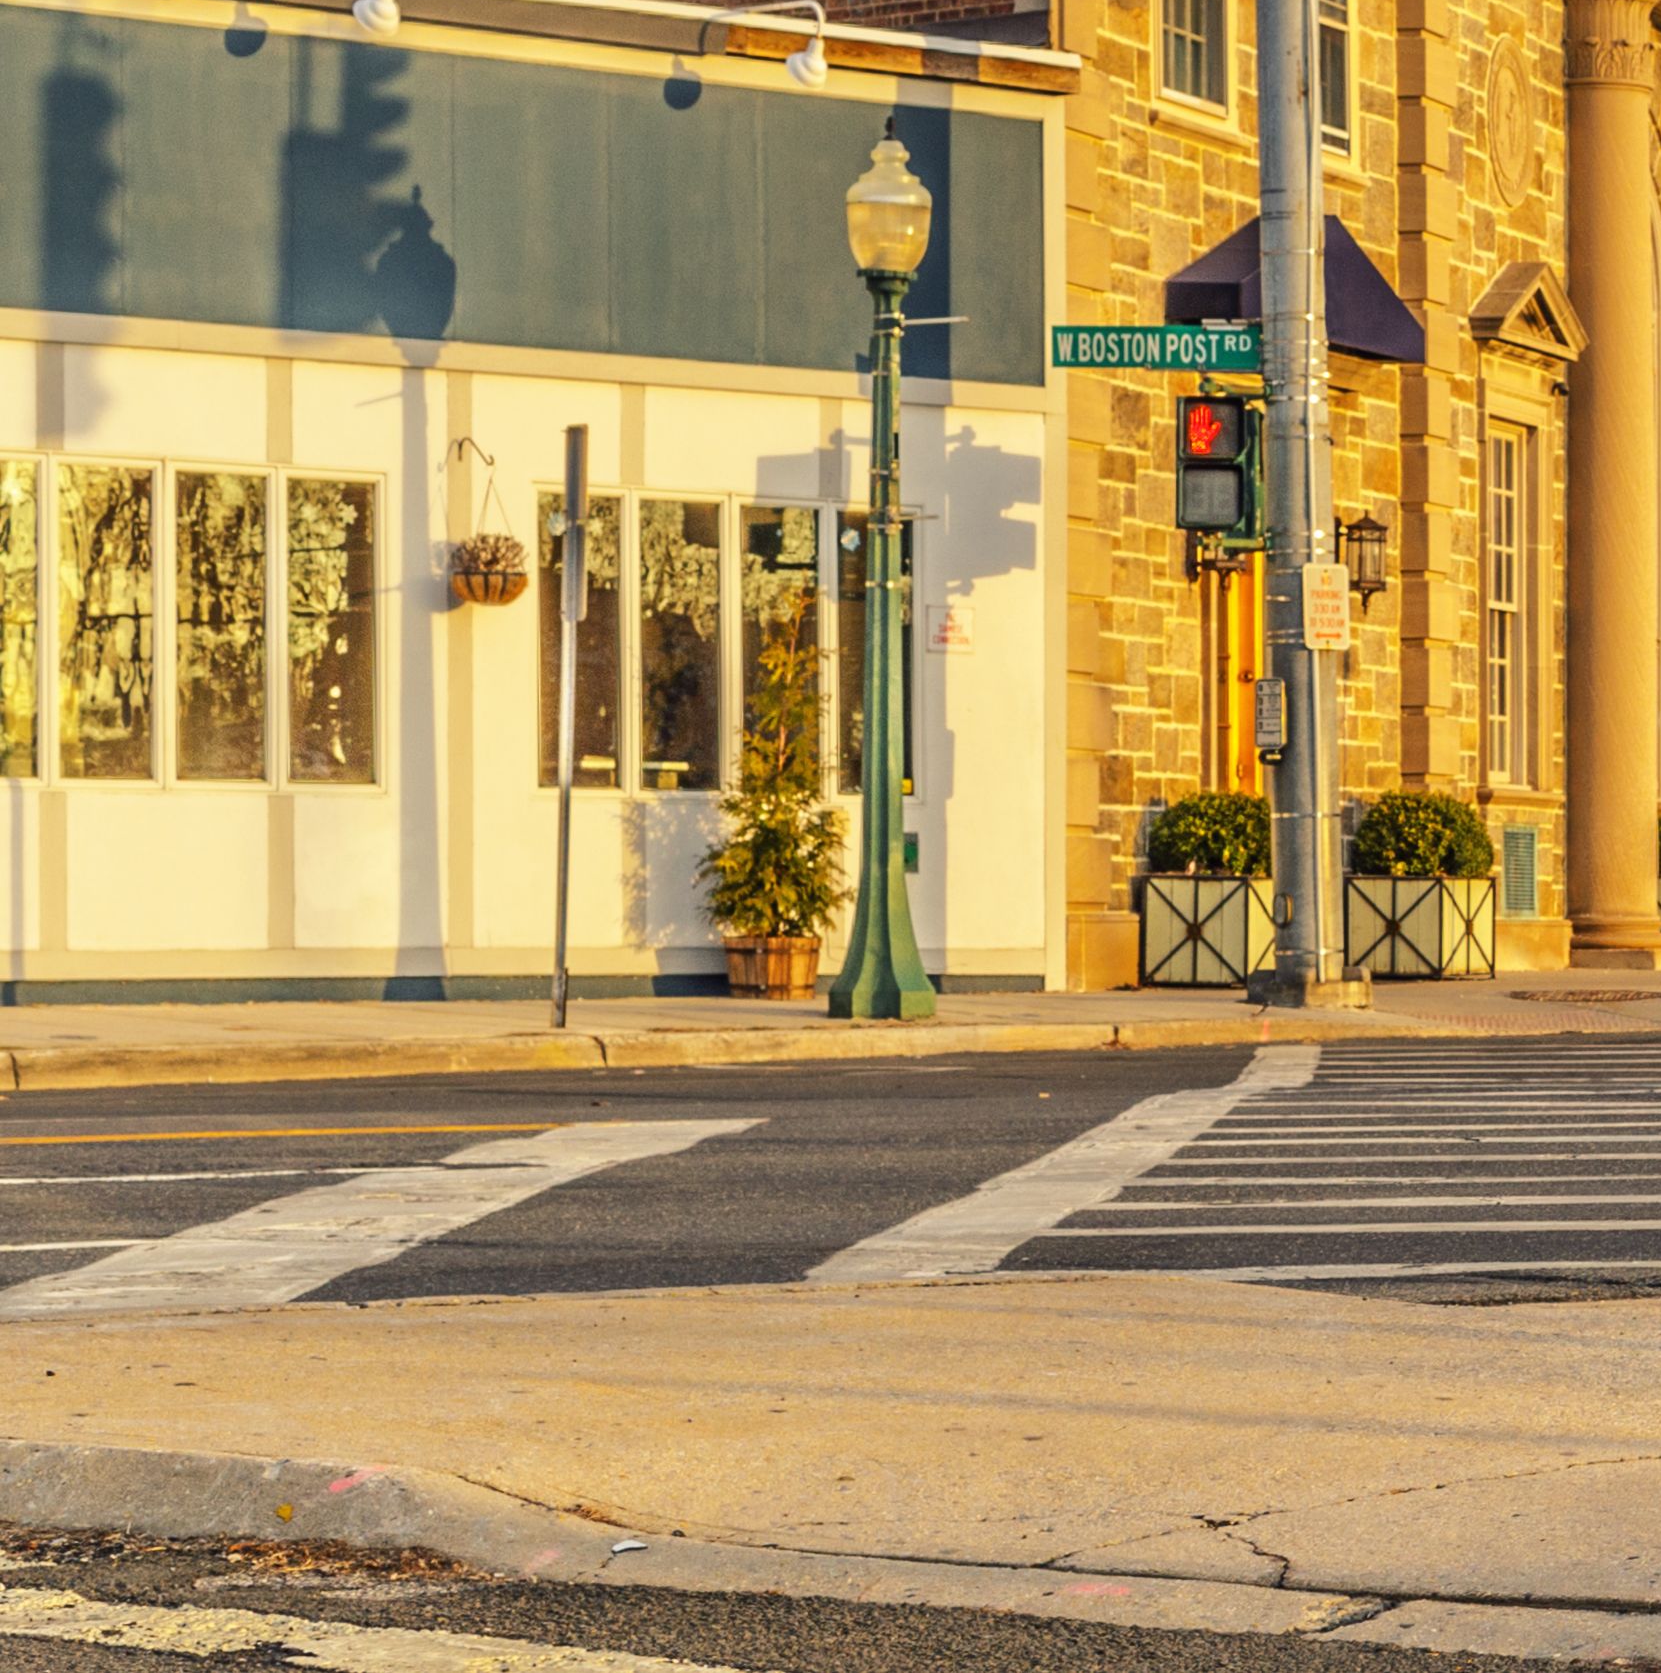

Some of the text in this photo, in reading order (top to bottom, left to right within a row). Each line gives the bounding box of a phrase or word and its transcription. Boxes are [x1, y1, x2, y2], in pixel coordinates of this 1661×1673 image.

[1077, 332, 1160, 363] BOSTON
[1165, 333, 1219, 364] POST
[1224, 334, 1251, 352] RD
